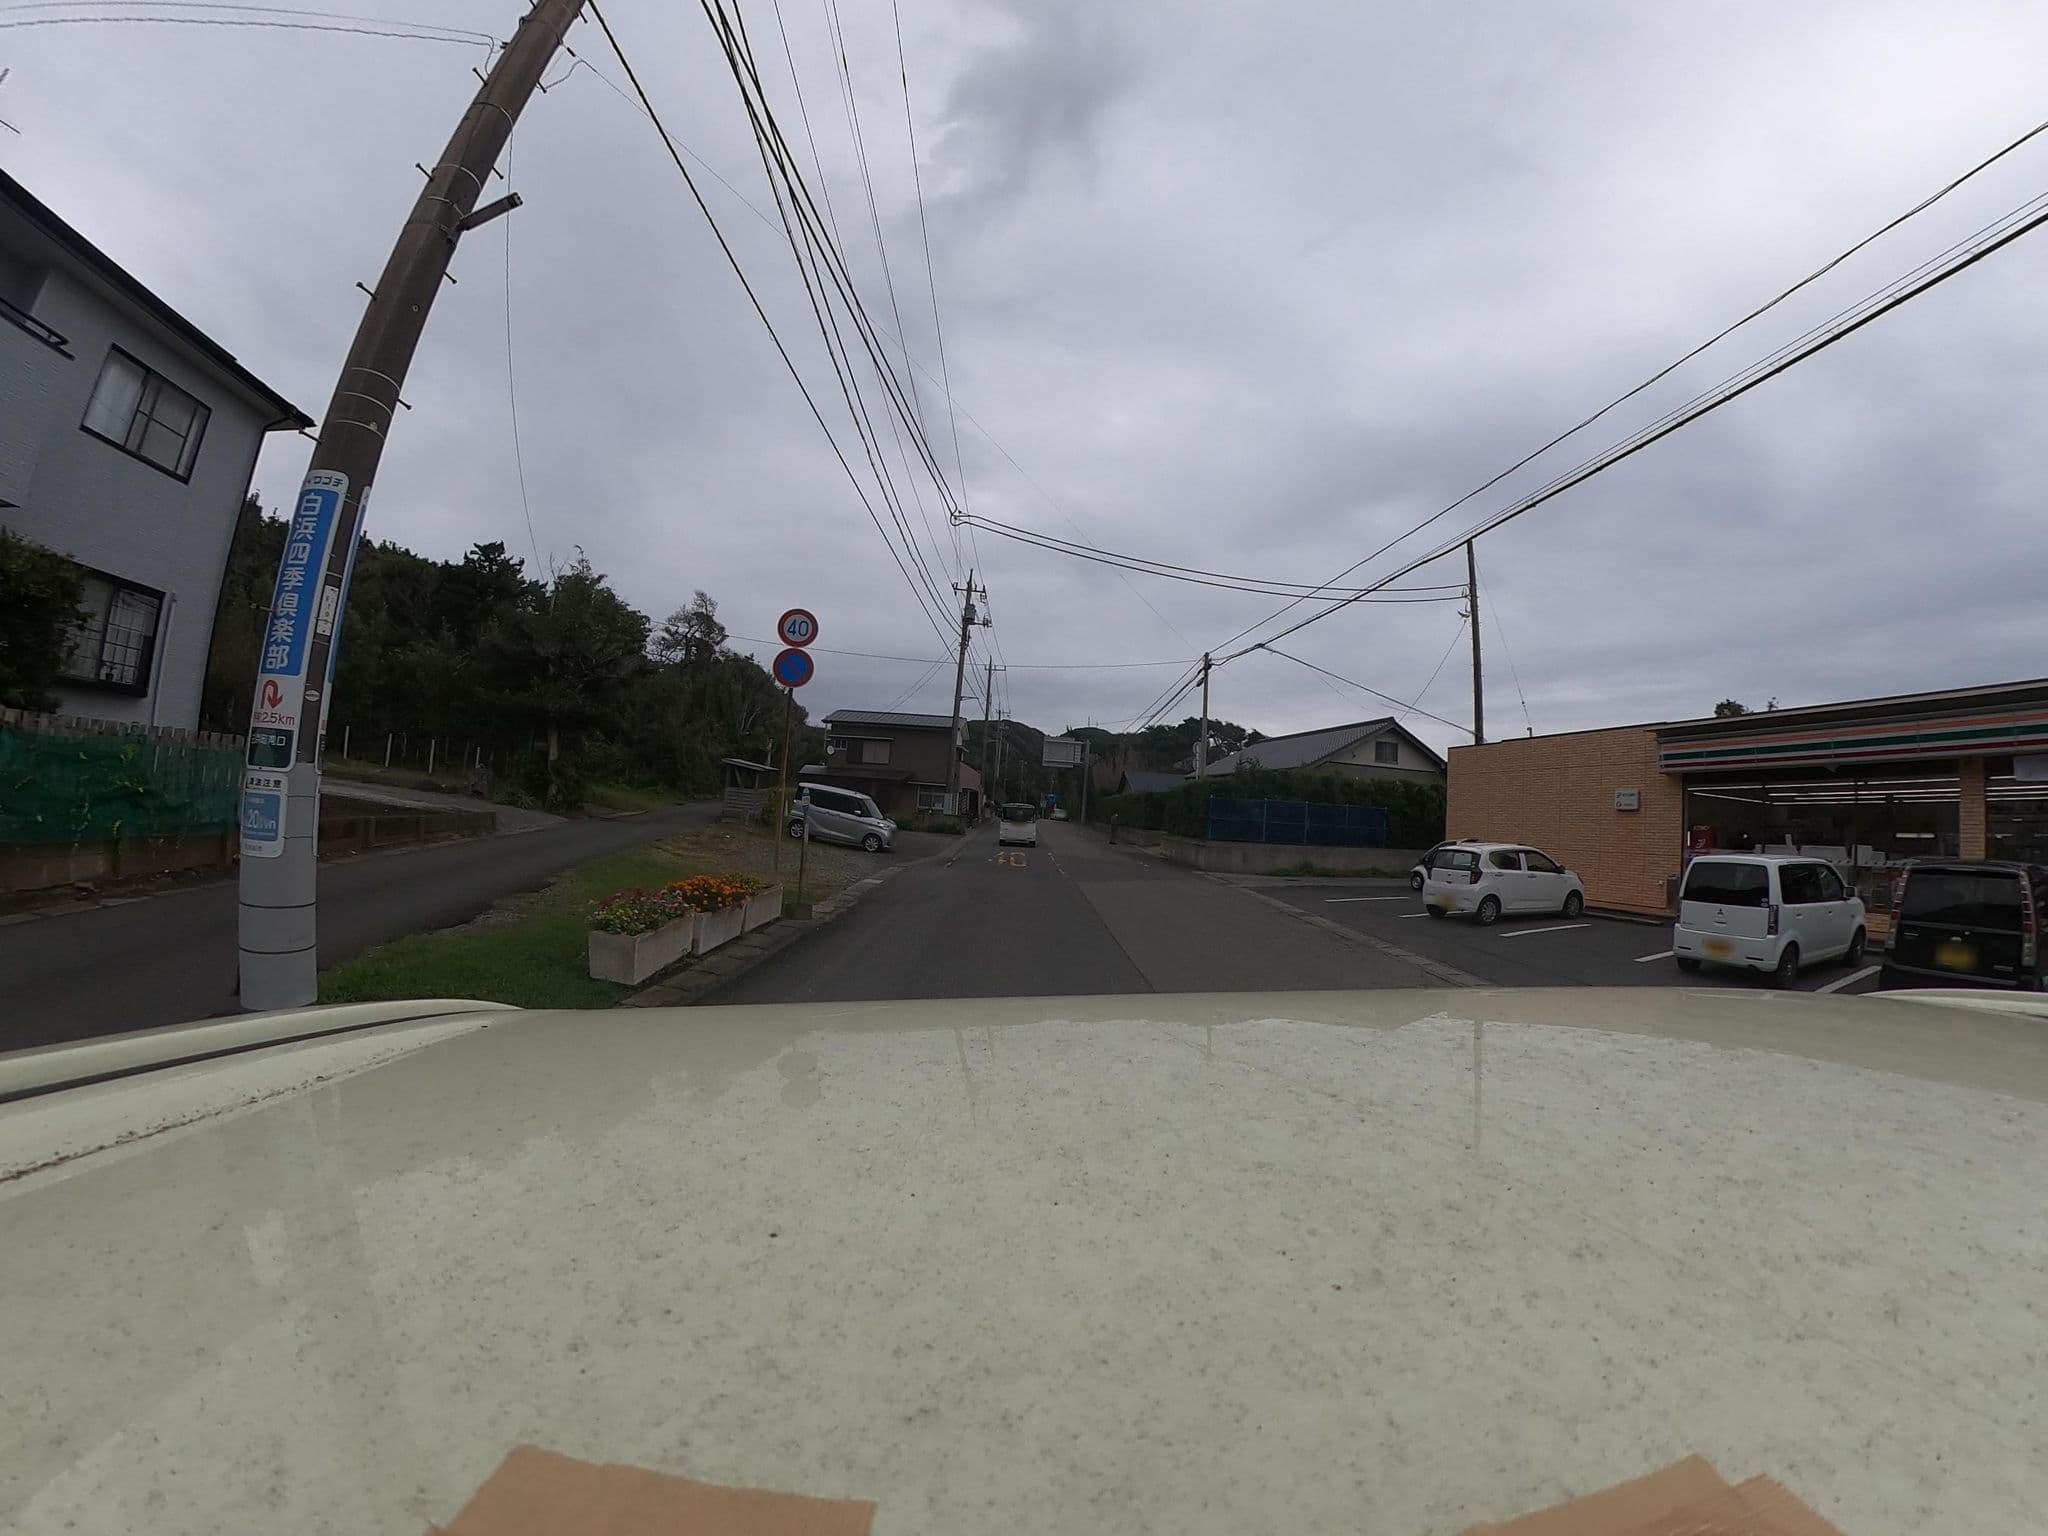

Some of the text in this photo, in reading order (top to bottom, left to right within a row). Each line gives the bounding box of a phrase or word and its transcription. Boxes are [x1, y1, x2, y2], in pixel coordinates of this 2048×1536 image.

[265, 492, 323, 670] 白浜四季倶楽部
[787, 619, 809, 637] 40
